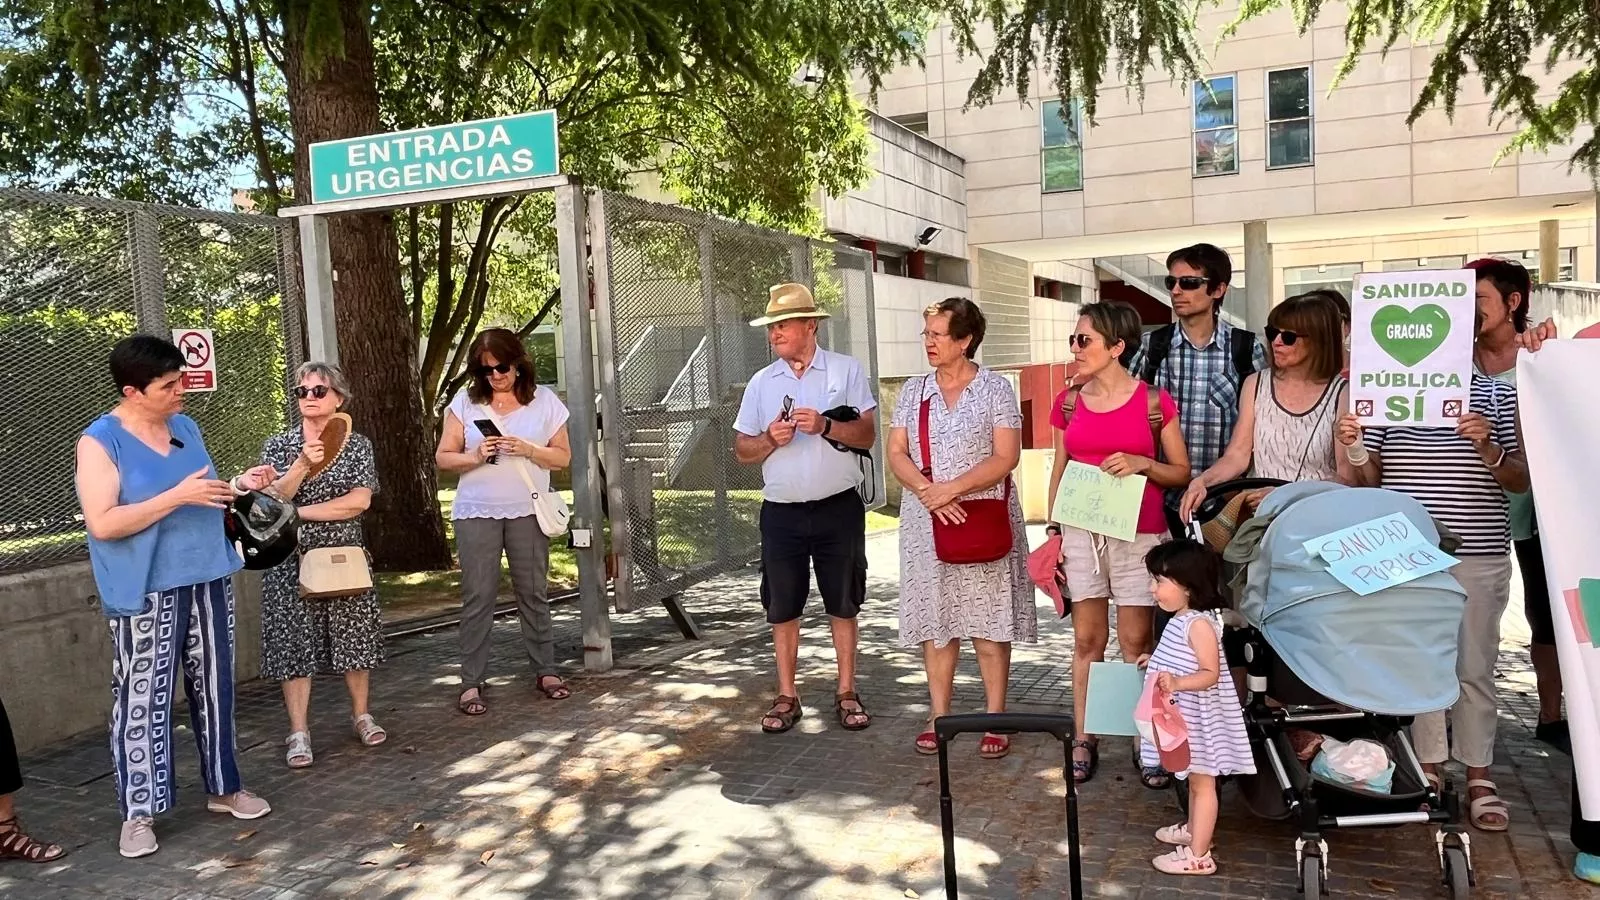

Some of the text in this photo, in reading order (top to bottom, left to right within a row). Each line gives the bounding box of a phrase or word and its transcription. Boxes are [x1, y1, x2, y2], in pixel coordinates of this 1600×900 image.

[348, 124, 511, 167] ENTRADA
[331, 149, 534, 195] URGENCIAS
[1362, 282, 1467, 299] SANIDAD
[1386, 323, 1433, 339] GRACIAS
[1360, 370, 1462, 388] PÚBLICA
[1384, 389, 1426, 422] SÍ
[1068, 466, 1123, 489] BASTA YA
[1064, 486, 1076, 497] DE
